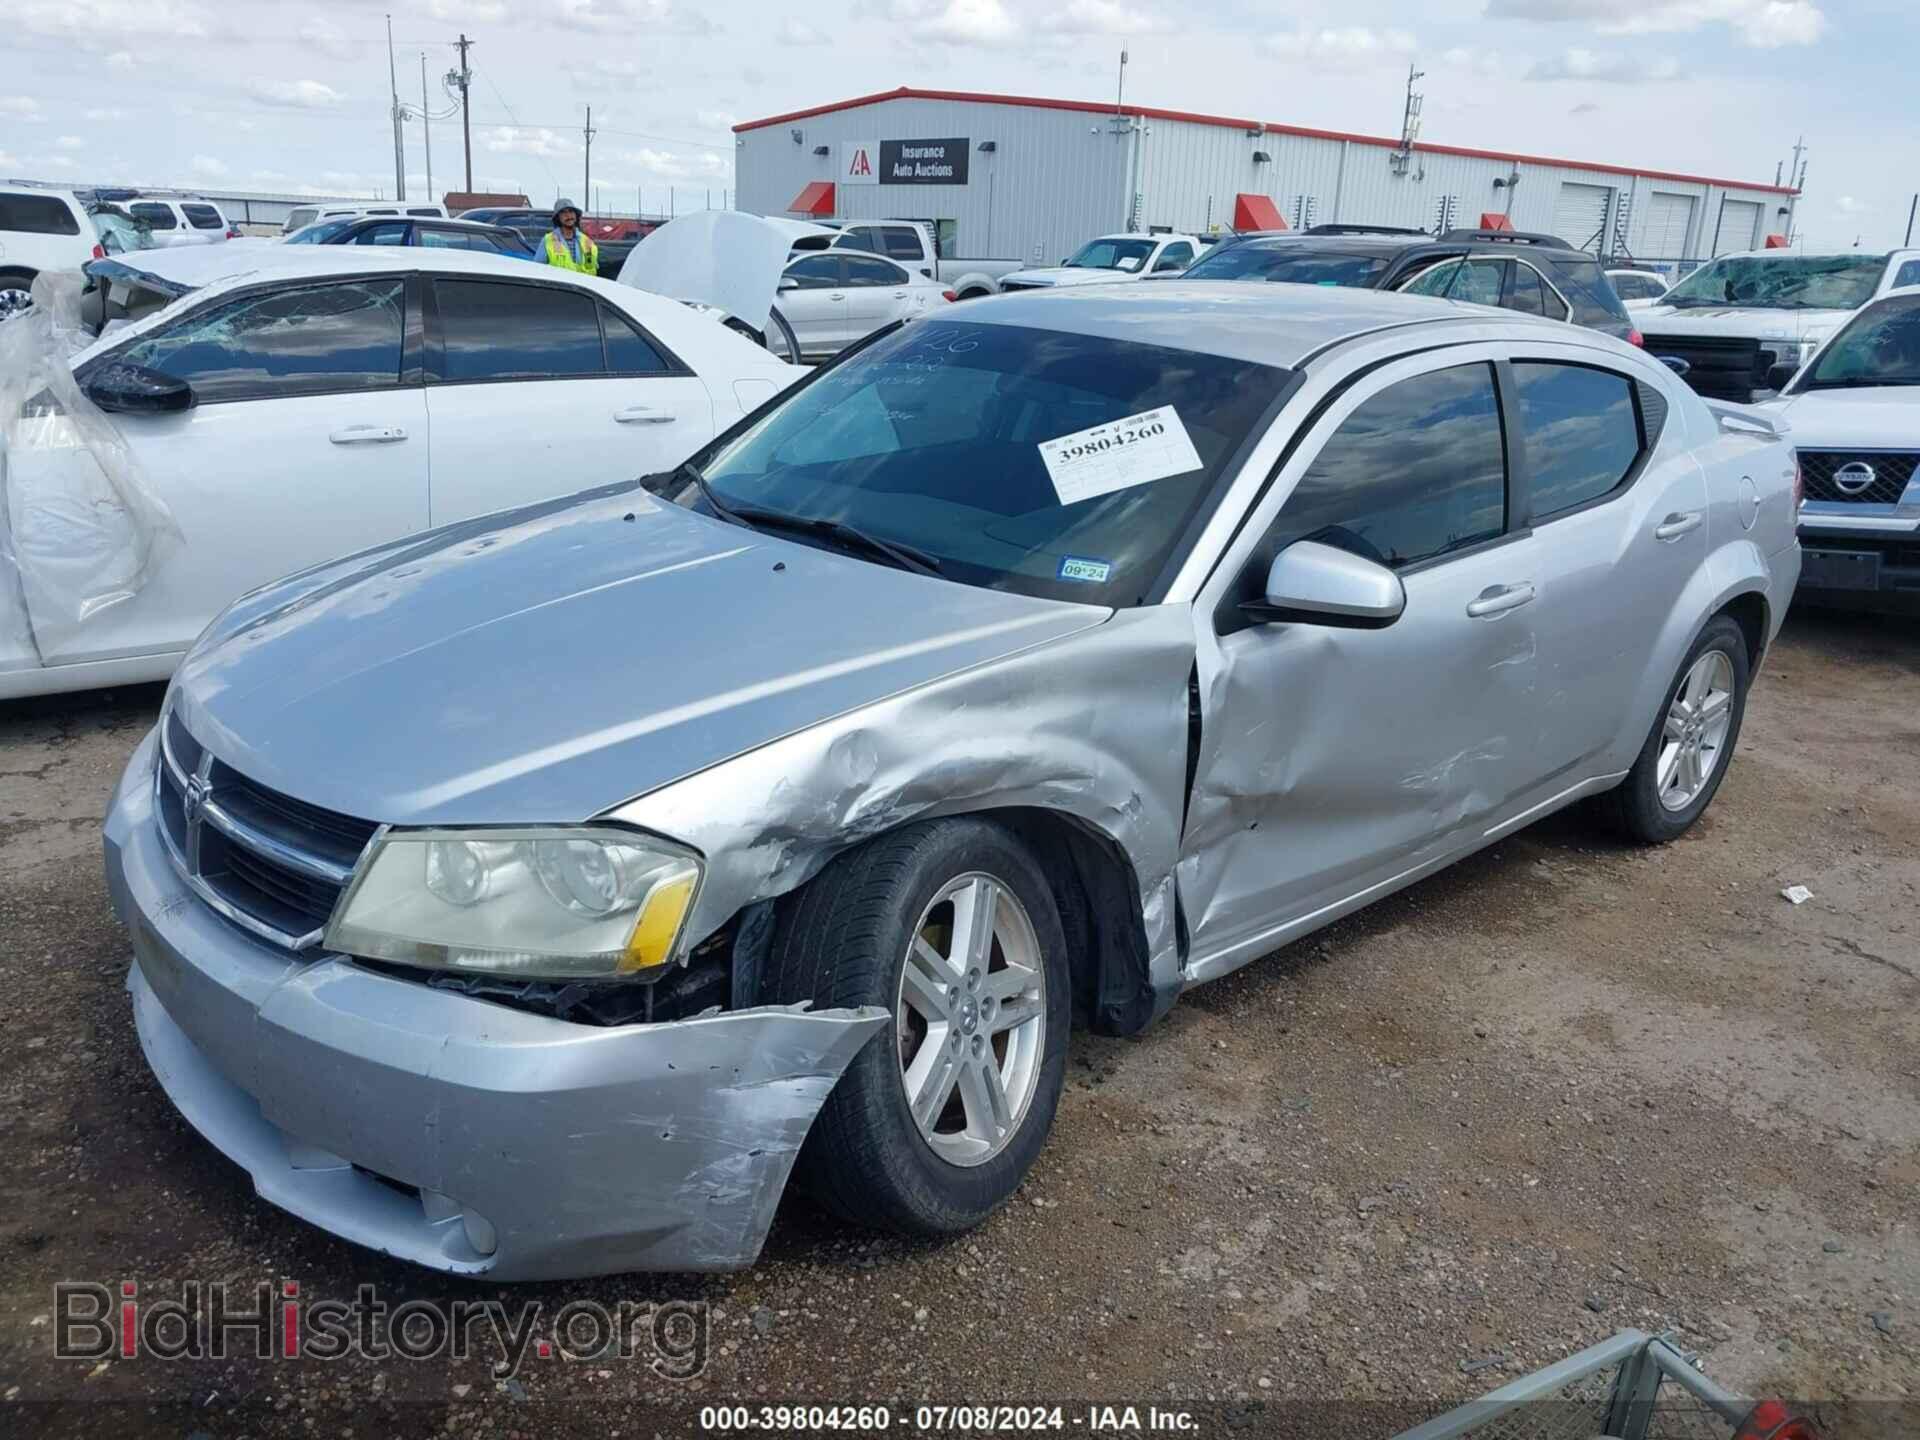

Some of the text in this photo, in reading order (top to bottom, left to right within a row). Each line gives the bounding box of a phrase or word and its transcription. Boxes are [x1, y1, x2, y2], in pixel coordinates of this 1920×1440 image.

[902, 144, 945, 159] Insurance
[892, 161, 953, 177] Auto Auctions
[1057, 422, 1166, 464] 39804260
